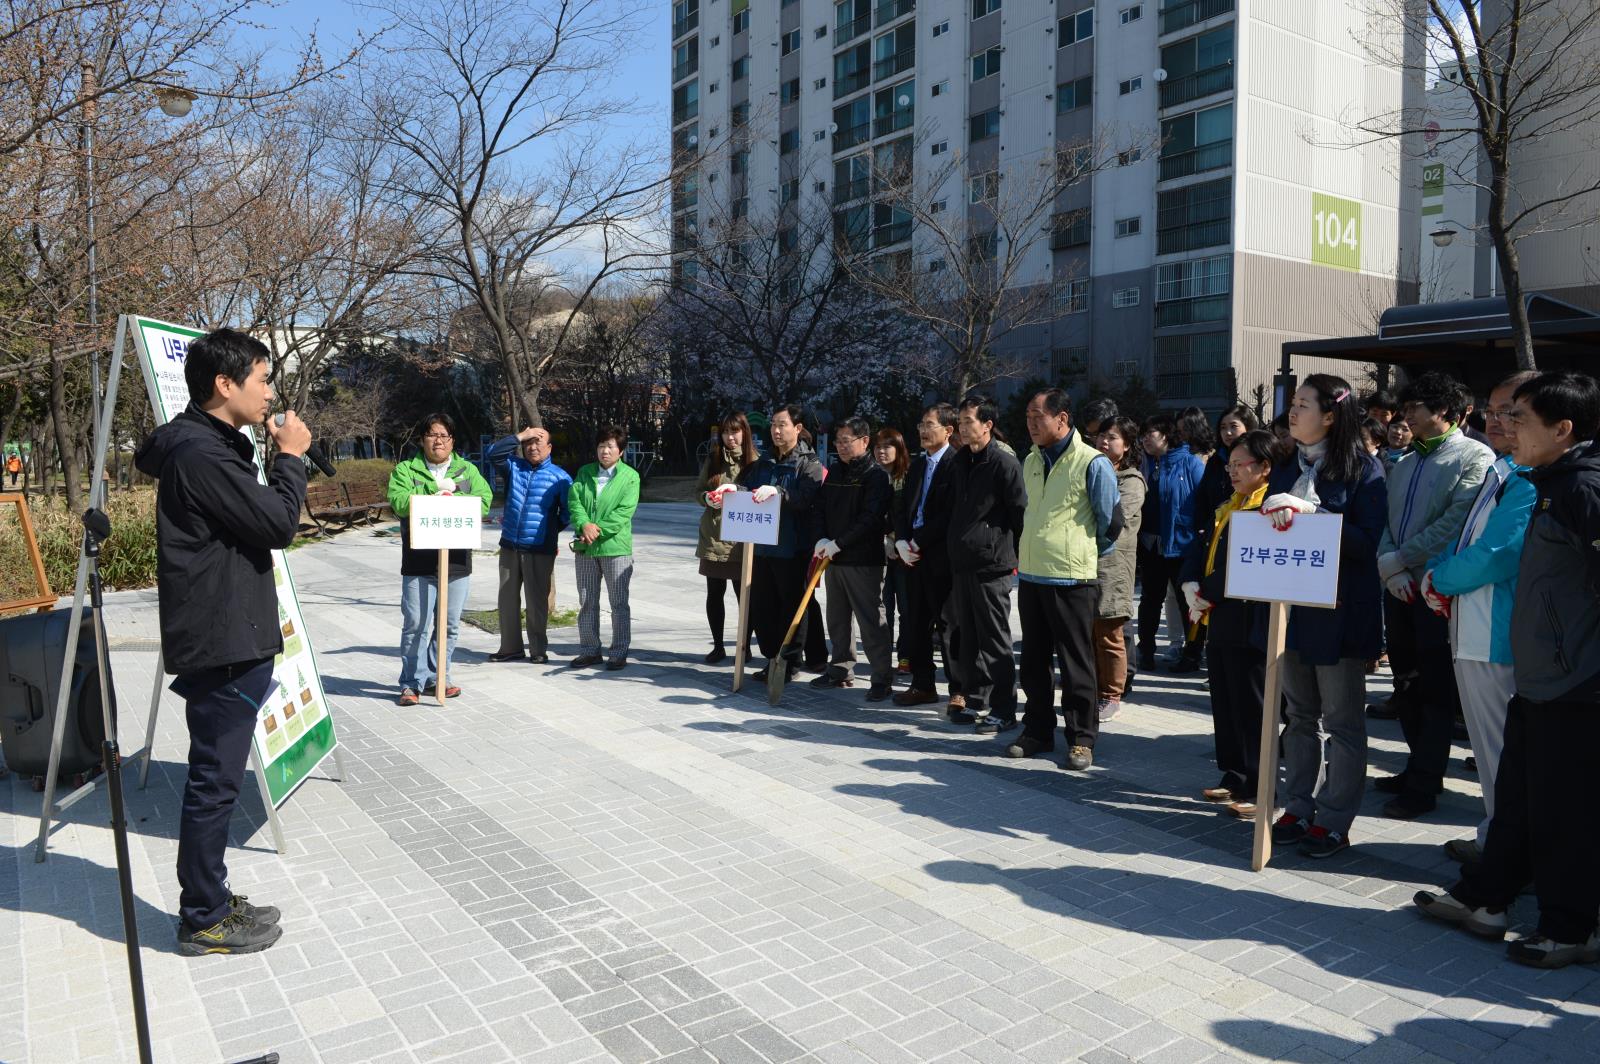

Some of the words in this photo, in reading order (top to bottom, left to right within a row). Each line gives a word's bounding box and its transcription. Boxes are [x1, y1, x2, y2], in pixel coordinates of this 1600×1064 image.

[1315, 209, 1358, 251] 104
[419, 516, 474, 529] 자치행정국
[728, 511, 773, 525] 복지경제국
[1240, 546, 1326, 568] 간부공무원
